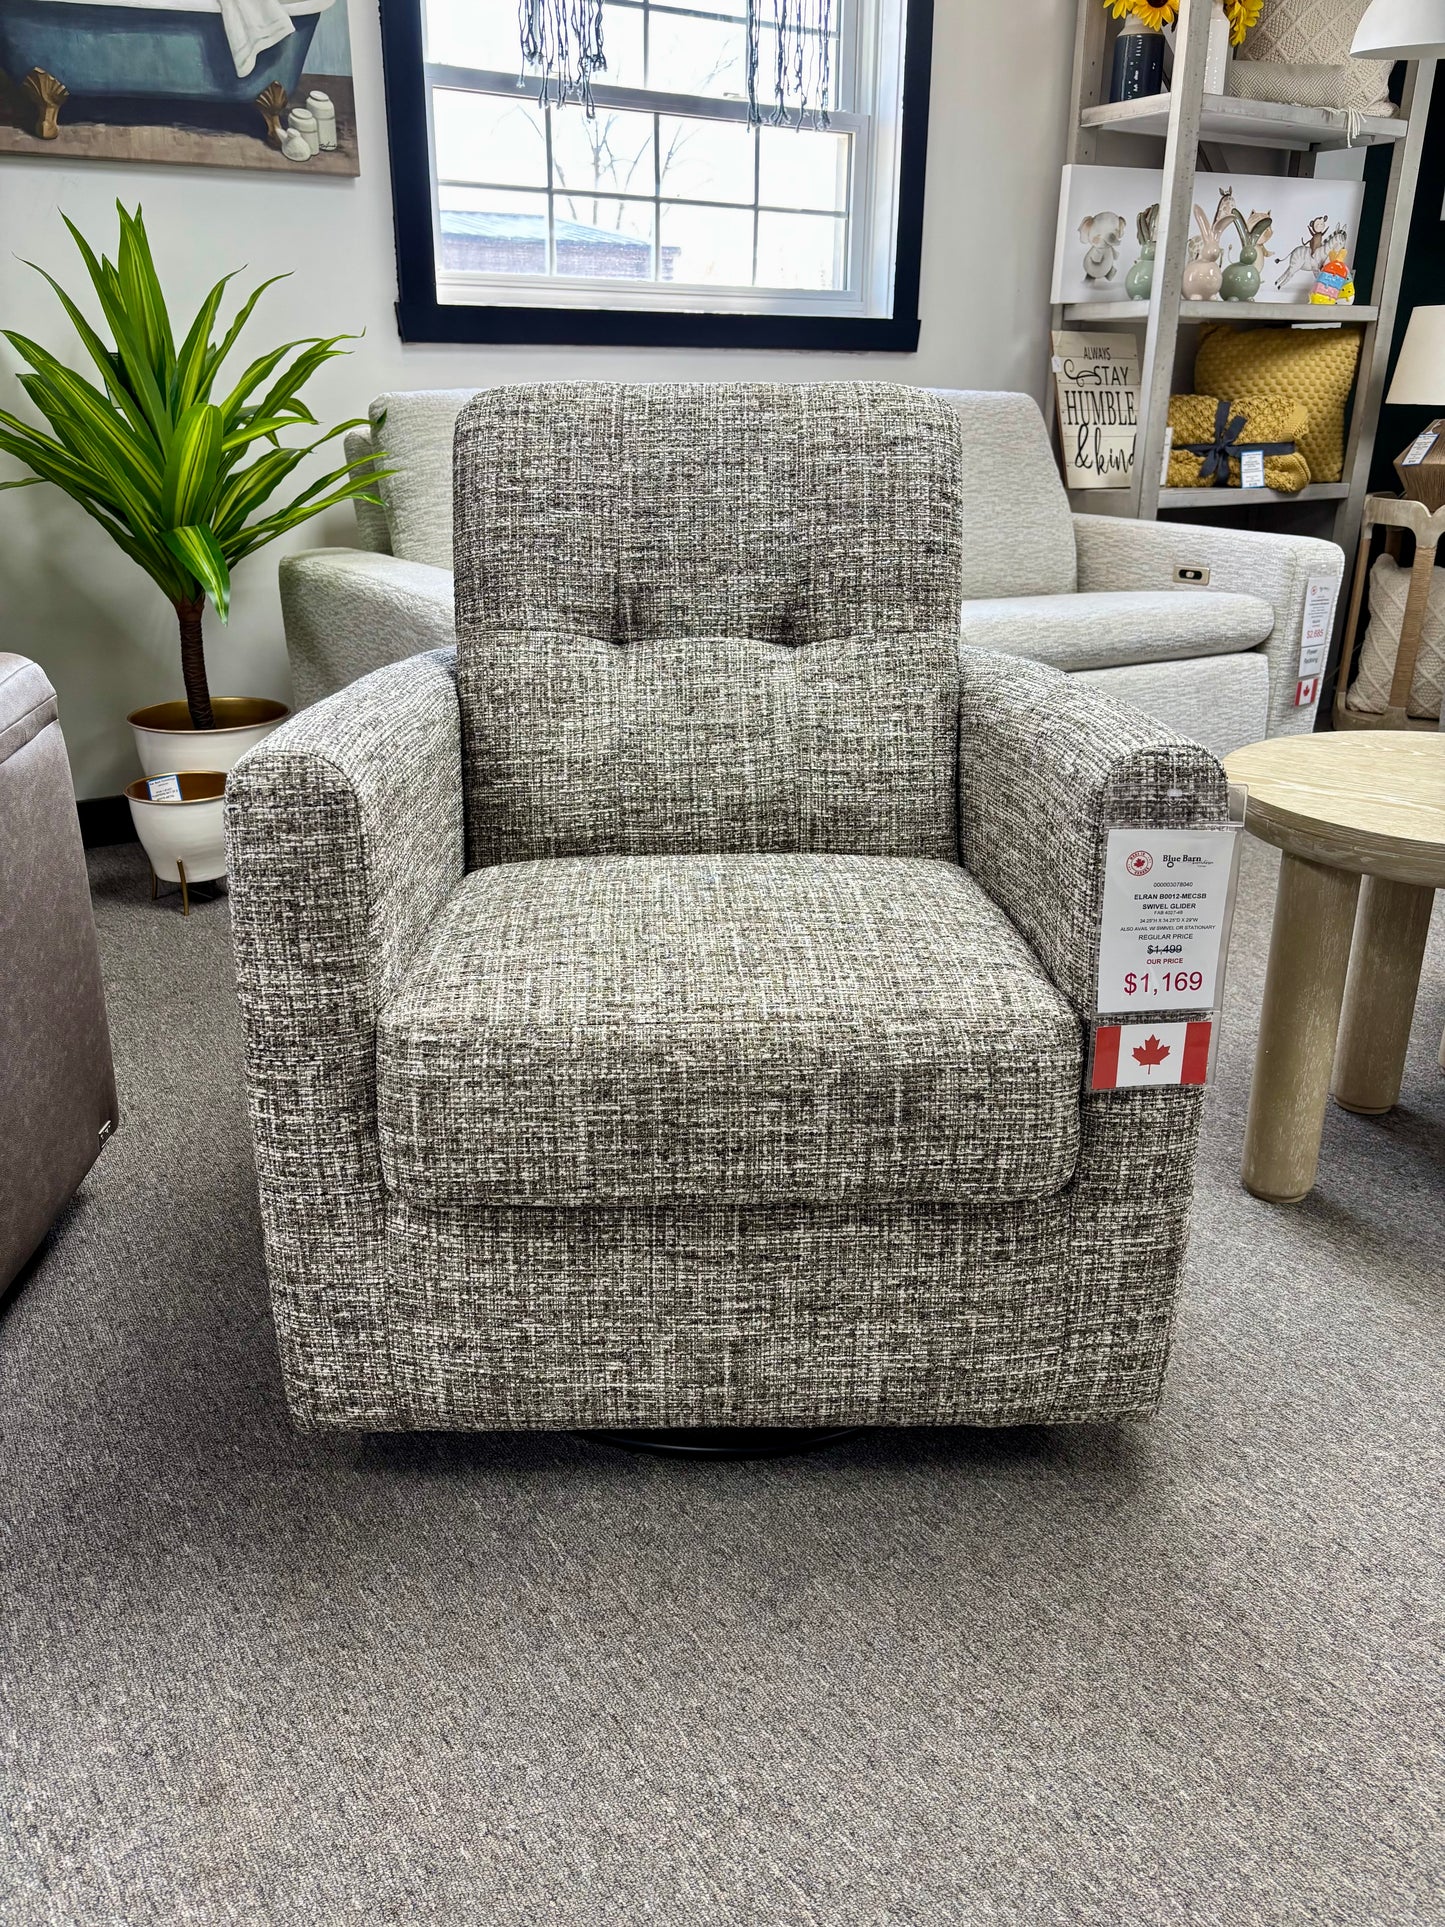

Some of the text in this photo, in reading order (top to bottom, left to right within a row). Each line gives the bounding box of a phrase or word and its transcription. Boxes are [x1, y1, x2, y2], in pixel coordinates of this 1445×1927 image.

[1083, 346, 1112, 361] ALWAYS
[1064, 390, 1137, 426] HUMBLE
[1074, 423, 1093, 469] &
[1094, 427, 1137, 476] kind
[1162, 854, 1181, 867] Blue
[1182, 854, 1202, 862] Barn
[1146, 944, 1183, 955] $1,499
[1123, 971, 1203, 996] $1,169
